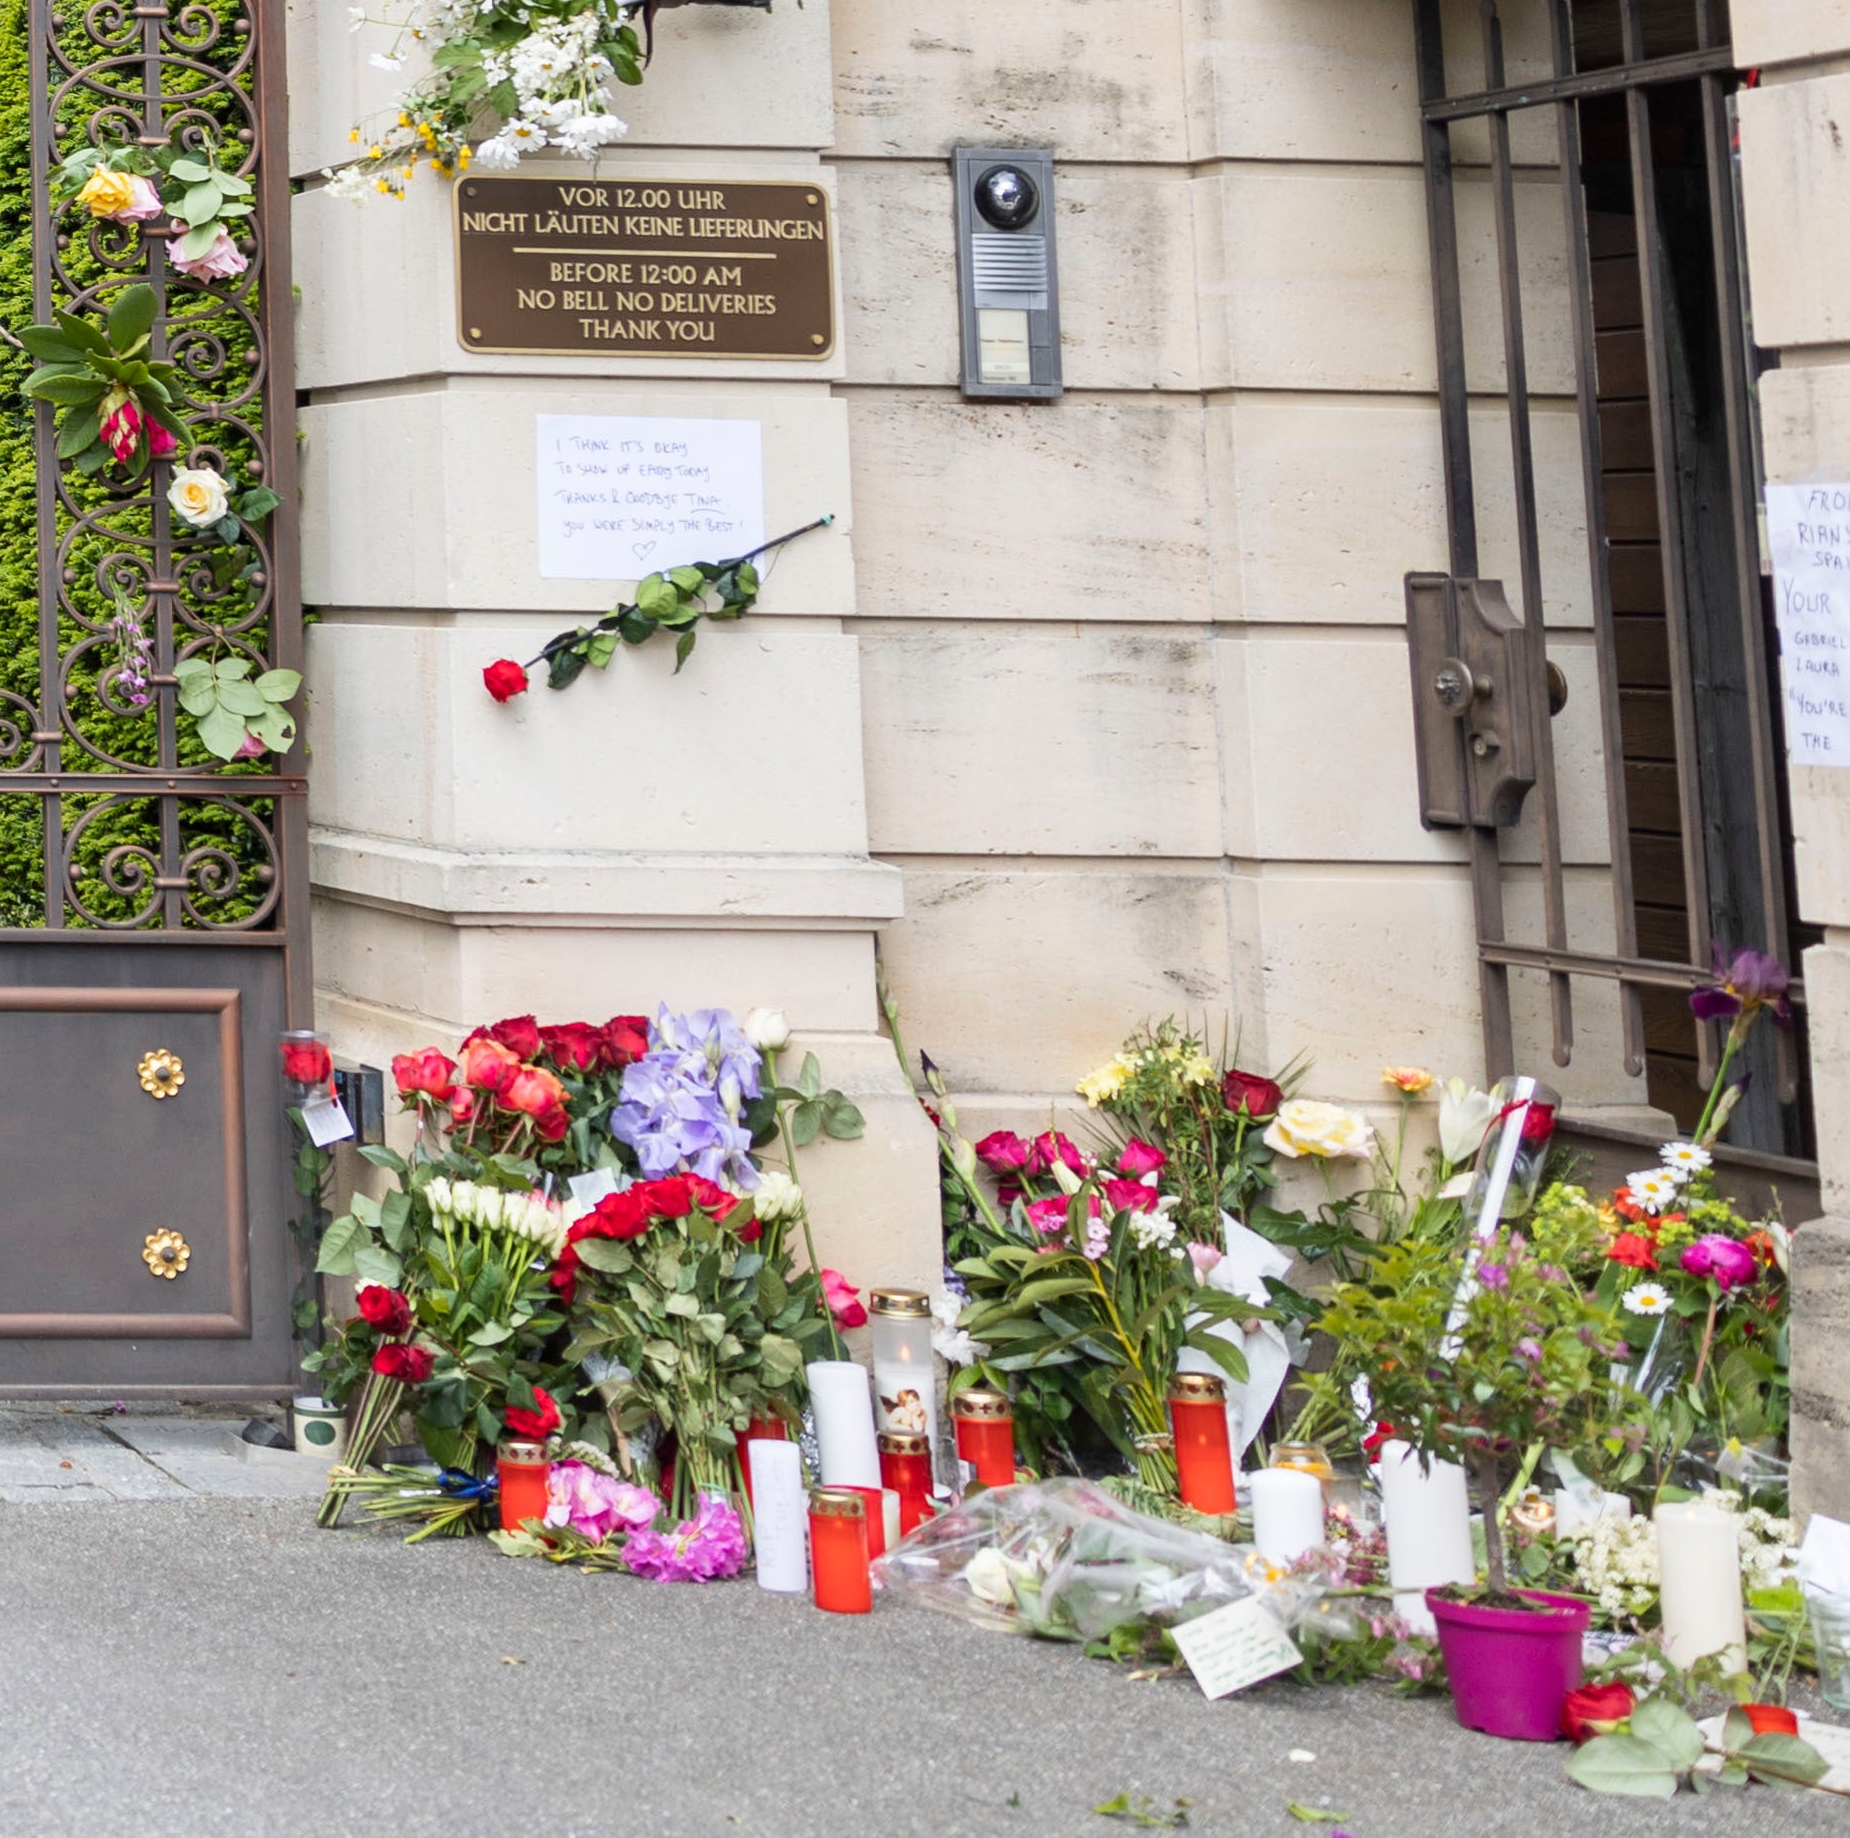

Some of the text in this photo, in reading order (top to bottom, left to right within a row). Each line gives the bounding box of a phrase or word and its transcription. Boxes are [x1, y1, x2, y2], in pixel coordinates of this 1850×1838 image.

[558, 186, 726, 210] VOR 12.00 UHR
[462, 210, 824, 240] NICHT LÄUTEN KEINE LIEFERUNGEN
[550, 261, 742, 287] BEFORE 12:00 AM
[516, 289, 777, 315] NO BELL NO DELIVERIES
[578, 318, 715, 341] THANK YOU
[569, 436, 612, 453] THINK
[621, 440, 644, 453] IT'S
[654, 442, 688, 458] OKAY
[556, 461, 572, 475] TO
[617, 463, 630, 475] UP
[554, 489, 607, 504] THANKS
[626, 491, 678, 510] GOODBYE
[1808, 489, 1850, 512] FRO
[678, 519, 701, 531] THE
[1783, 577, 1832, 616] YOUR
[1796, 657, 1840, 677] LAURA
[1801, 732, 1830, 750] THE
